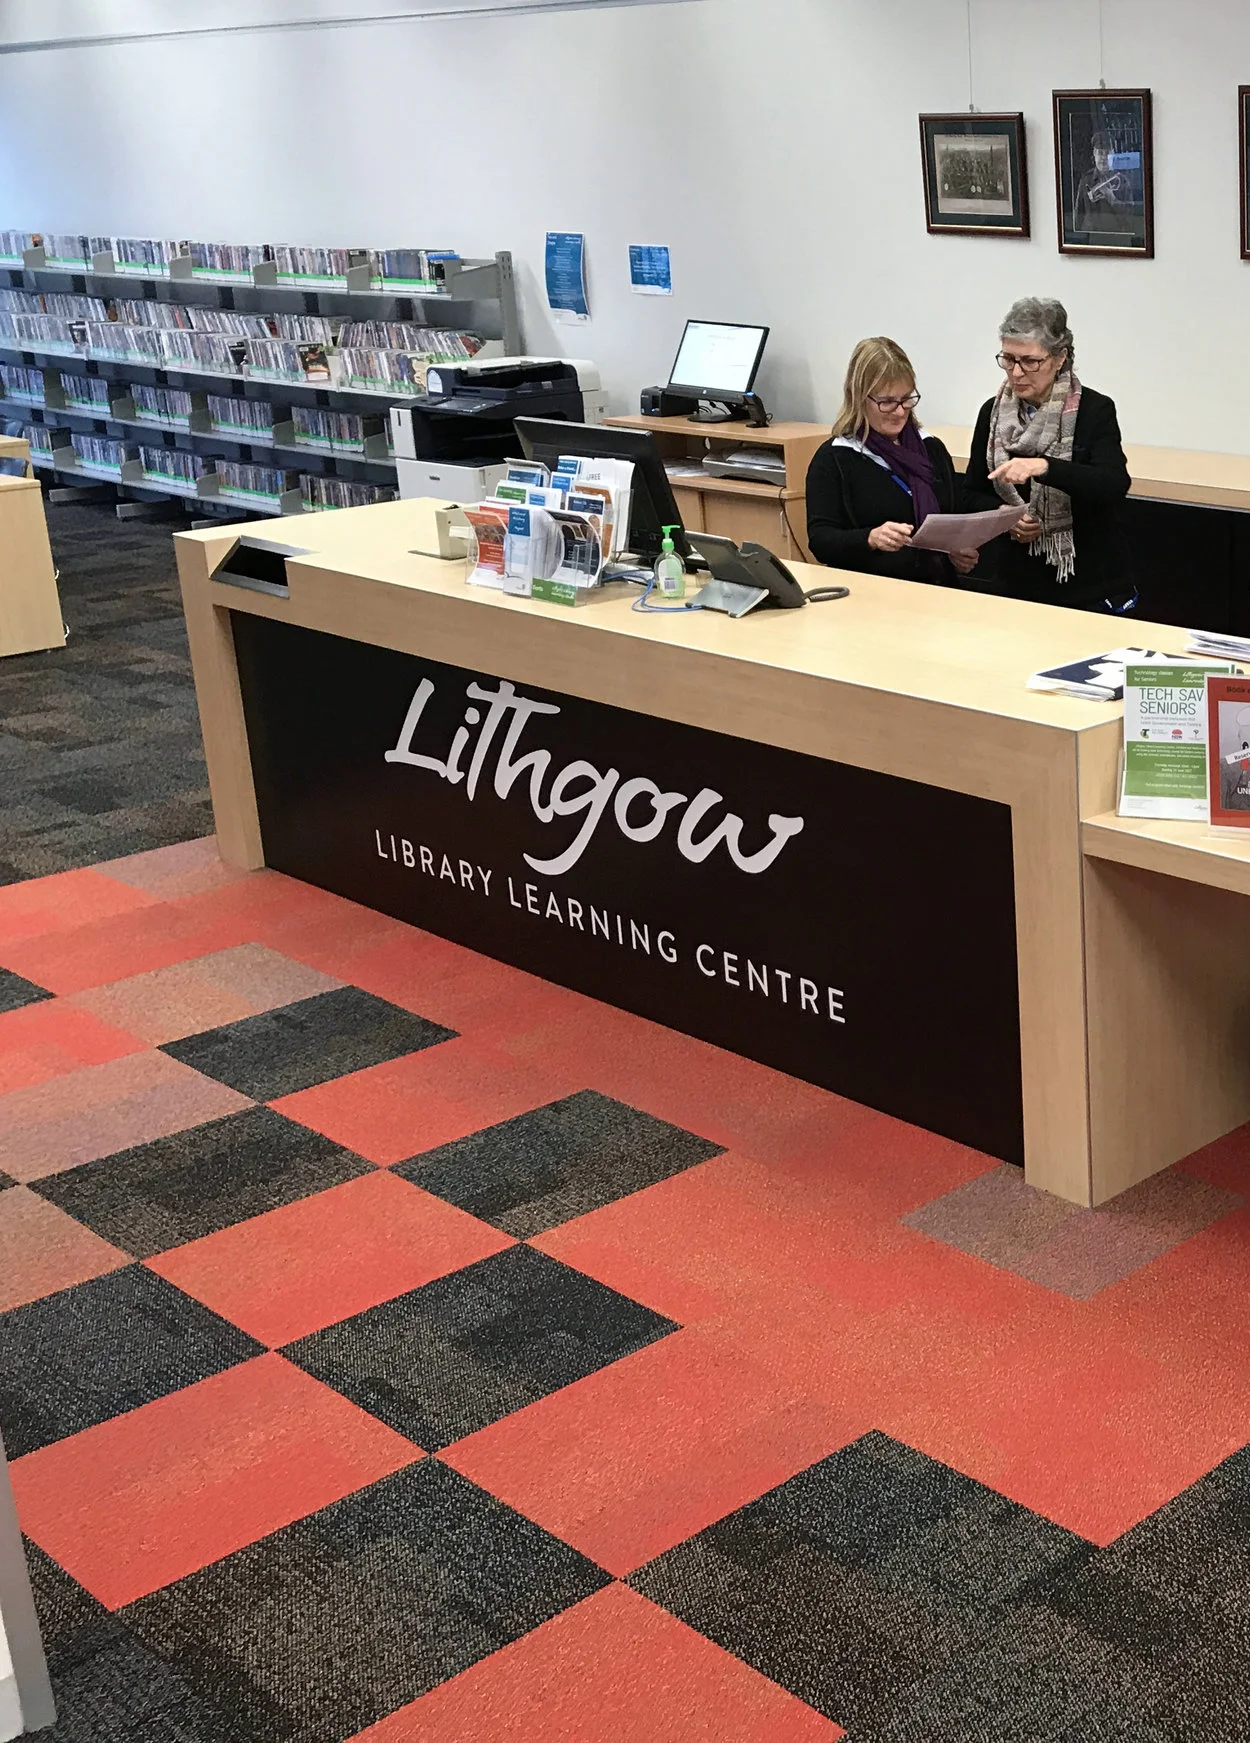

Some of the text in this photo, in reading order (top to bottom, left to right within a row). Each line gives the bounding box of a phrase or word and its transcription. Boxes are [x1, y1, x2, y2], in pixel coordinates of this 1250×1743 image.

[1139, 687, 1204, 702] TECH SAV
[1226, 686, 1245, 694] Book
[1139, 701, 1197, 715] SENIORS
[375, 829, 846, 1024] LIBRARY LEARNING CENTRE
